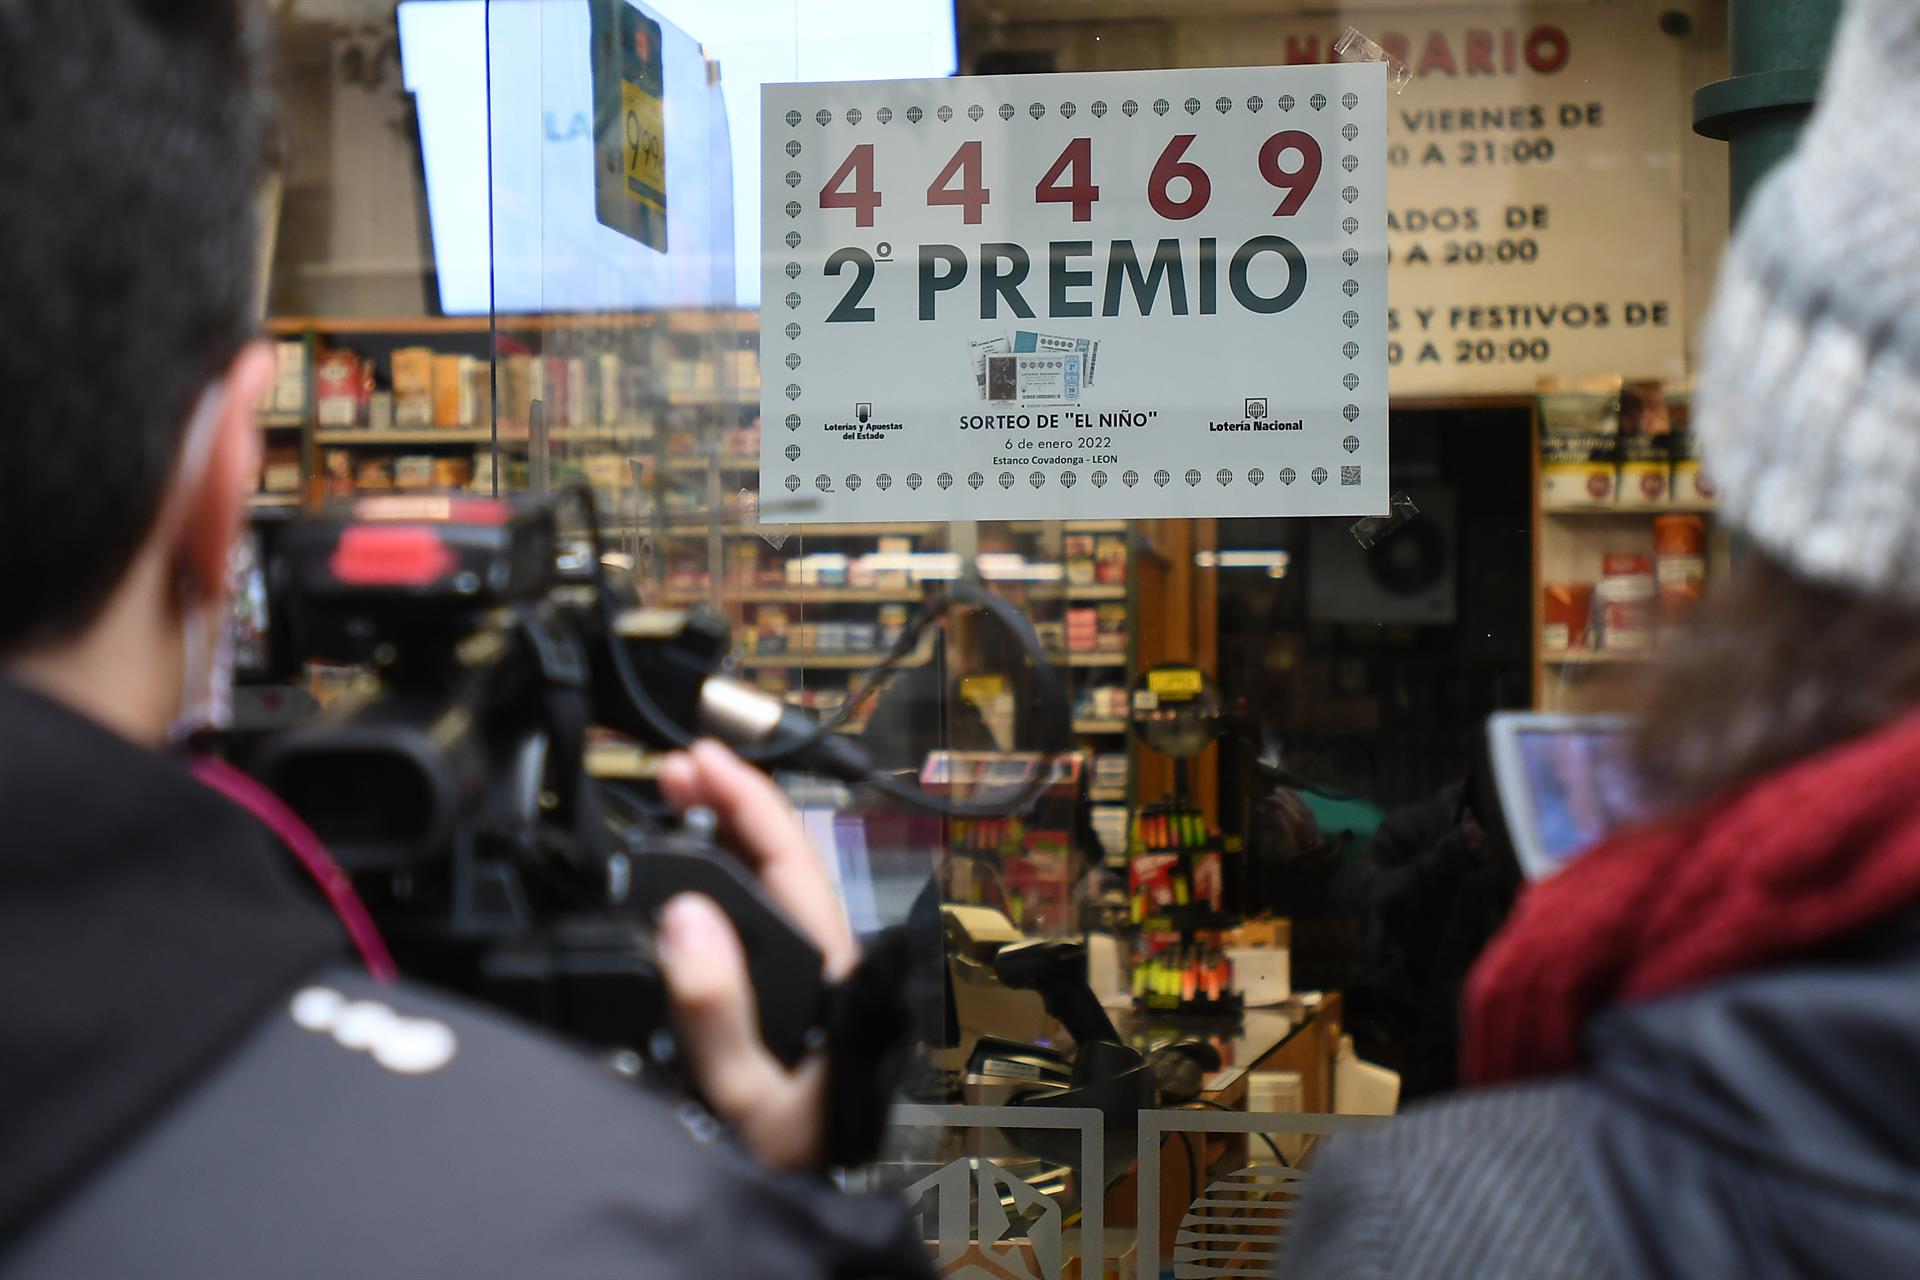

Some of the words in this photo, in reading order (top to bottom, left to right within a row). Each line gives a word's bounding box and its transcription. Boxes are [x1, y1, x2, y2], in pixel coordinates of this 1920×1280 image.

[1285, 25, 1570, 78] HRARIO
[1402, 104, 1545, 132] VIERNES
[1559, 103, 1604, 128] DE
[1422, 142, 1445, 165] A
[1459, 138, 1555, 166] 21:00
[1504, 205, 1549, 230] DE
[1406, 244, 1429, 265] A
[918, 235, 1308, 321] PREMIO
[1414, 308, 1434, 330] Y
[1449, 304, 1610, 331] FESTIVOS
[1624, 302, 1669, 328] DE
[1417, 343, 1440, 364] A
[824, 423, 857, 432] Loterías
[865, 422, 903, 432] Apuestas
[959, 414, 1030, 430] SORTEO
[1036, 414, 1059, 429] DE
[1065, 412, 1093, 428] "EL
[1099, 409, 1158, 428] NIÑO"
[1209, 420, 1251, 432] Lotería
[1253, 419, 1303, 432] Nacional
[842, 432, 855, 440] del
[856, 432, 885, 440] Estado
[1004, 438, 1013, 450] 6
[1017, 438, 1034, 449] de
[1037, 440, 1073, 449] enero
[1077, 436, 1111, 449] 2022
[993, 456, 1029, 466] Estanco
[1031, 455, 1084, 467] Covadonga
